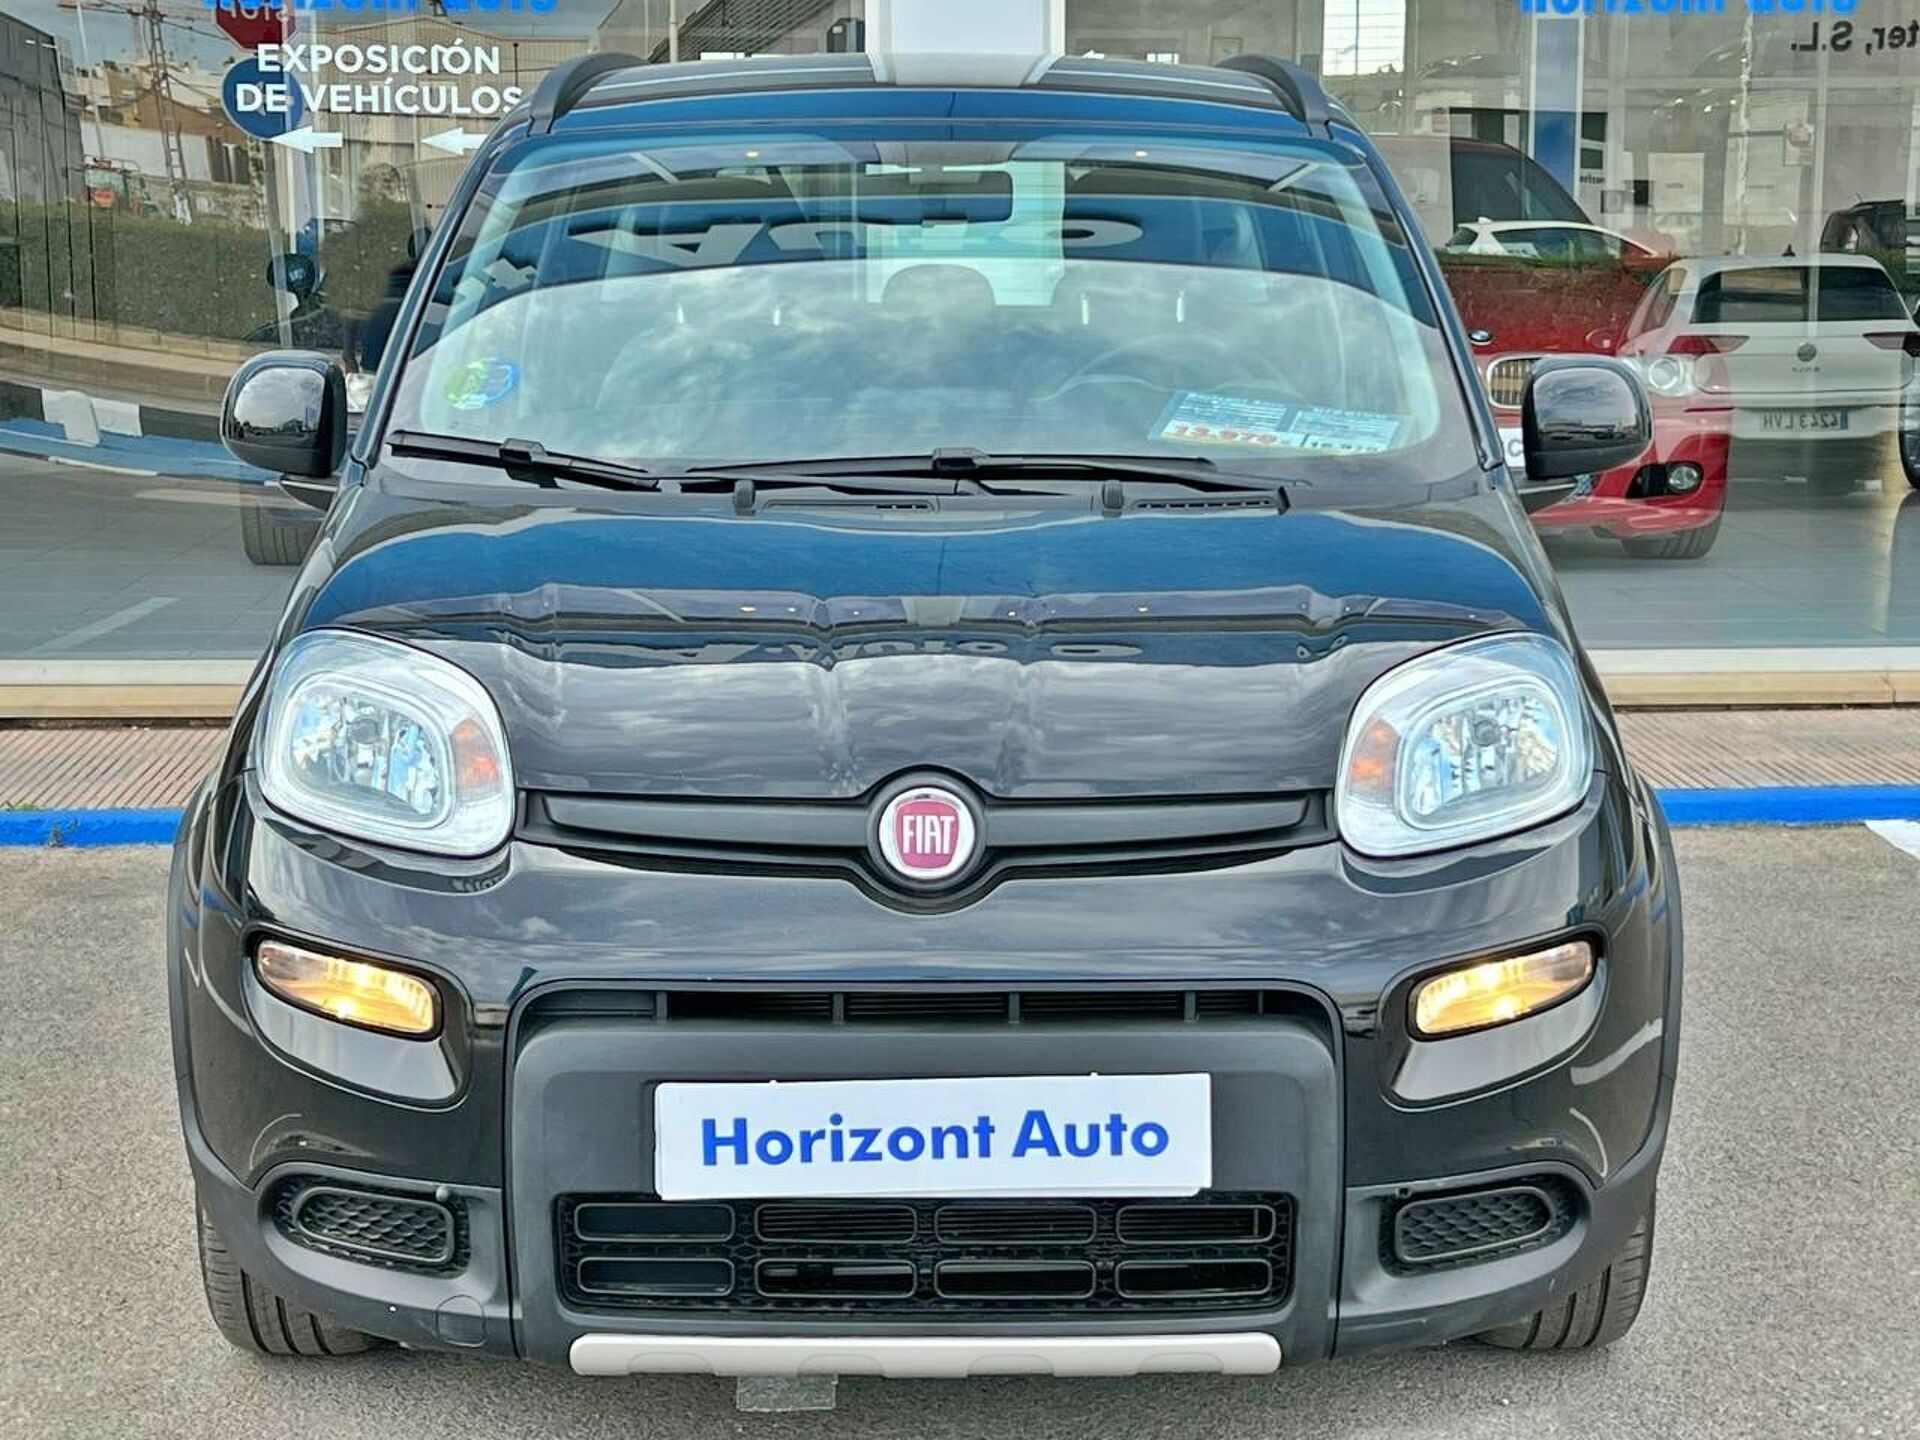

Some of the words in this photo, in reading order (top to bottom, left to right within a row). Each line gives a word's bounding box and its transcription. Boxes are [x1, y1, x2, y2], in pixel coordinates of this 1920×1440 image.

[257, 38, 500, 75] EXPOSICIÓN
[235, 83, 289, 112] DE
[303, 77, 524, 115] VEHÍCULOS
[902, 814, 955, 855] FIAT
[702, 1113, 996, 1166] Horizont
[1012, 1110, 1169, 1158] Auto
